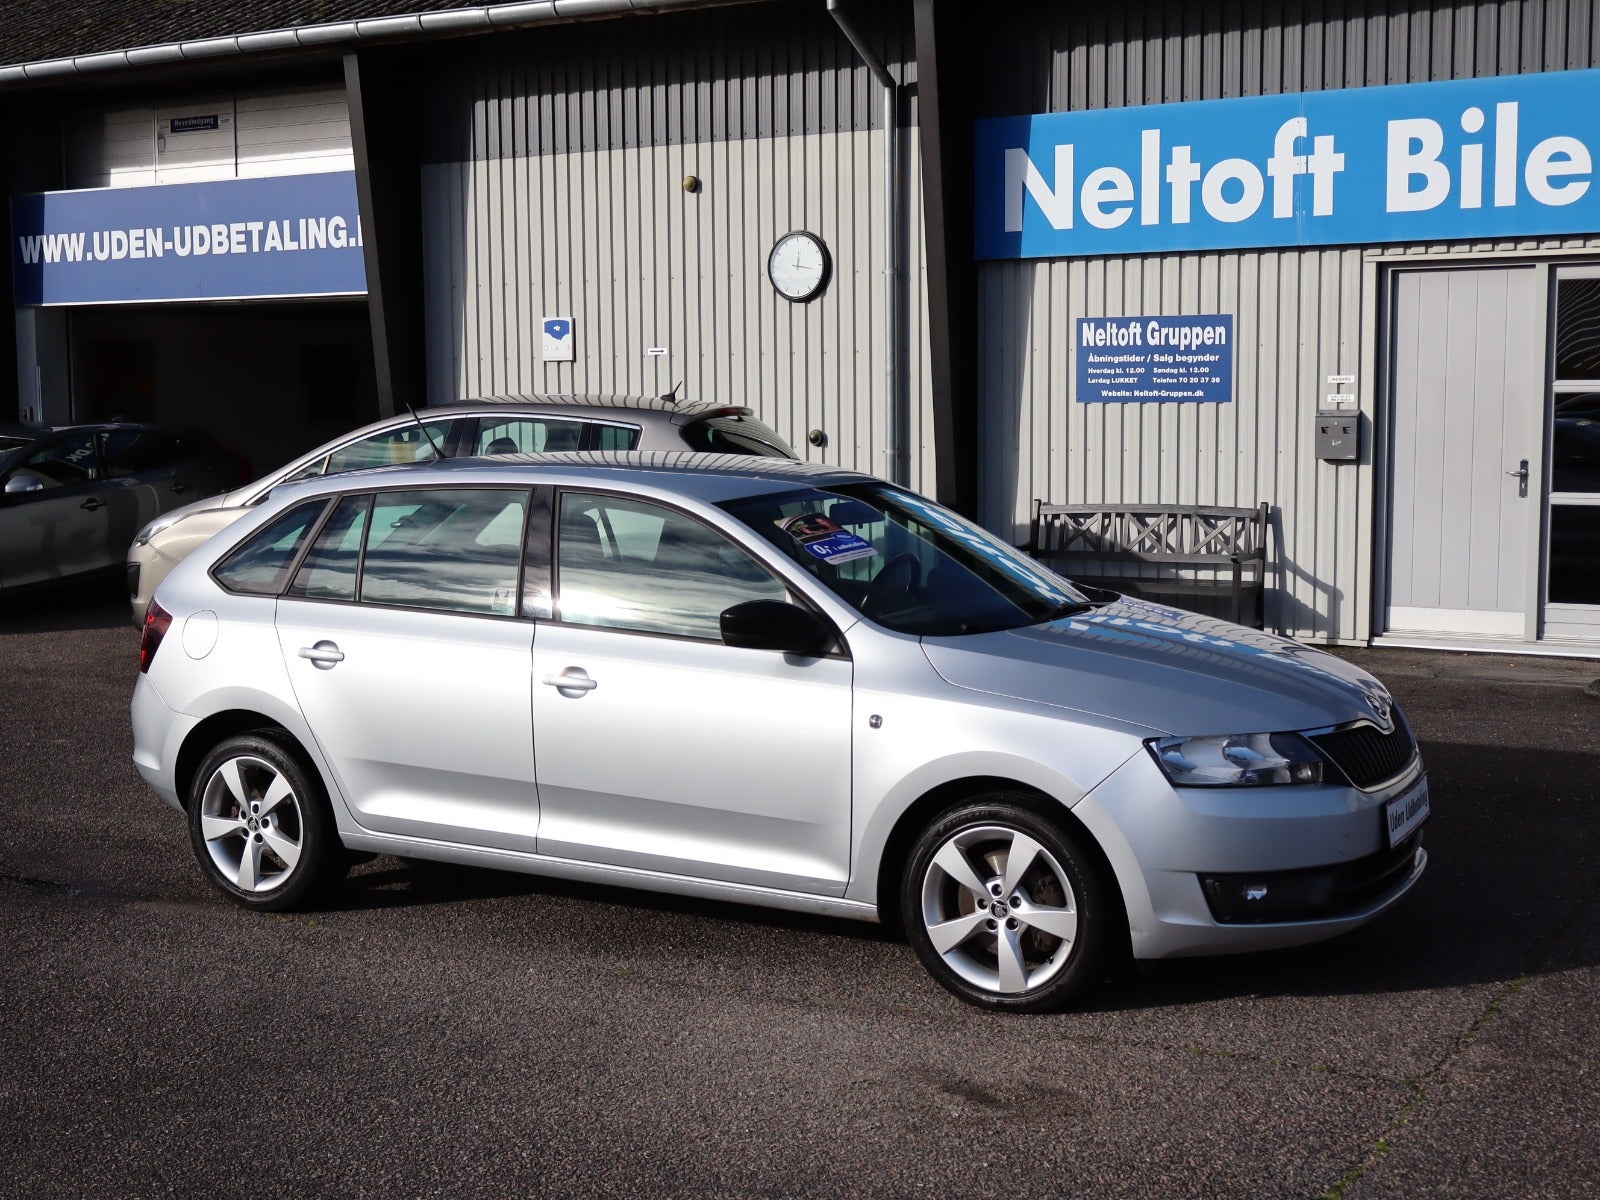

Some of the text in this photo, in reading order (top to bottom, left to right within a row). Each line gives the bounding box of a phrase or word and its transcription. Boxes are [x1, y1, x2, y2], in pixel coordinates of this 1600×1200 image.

[1004, 101, 1592, 232] Neltoft Bile
[1082, 320, 1226, 350] Neltoft Gruppen
[1088, 353, 1145, 363] Åbningstider
[1153, 354, 1174, 363] Salg
[1176, 354, 1220, 363] begynder
[1133, 390, 1205, 398] Neltoft-Gruppen.dk
[1389, 810, 1405, 833] Uden
